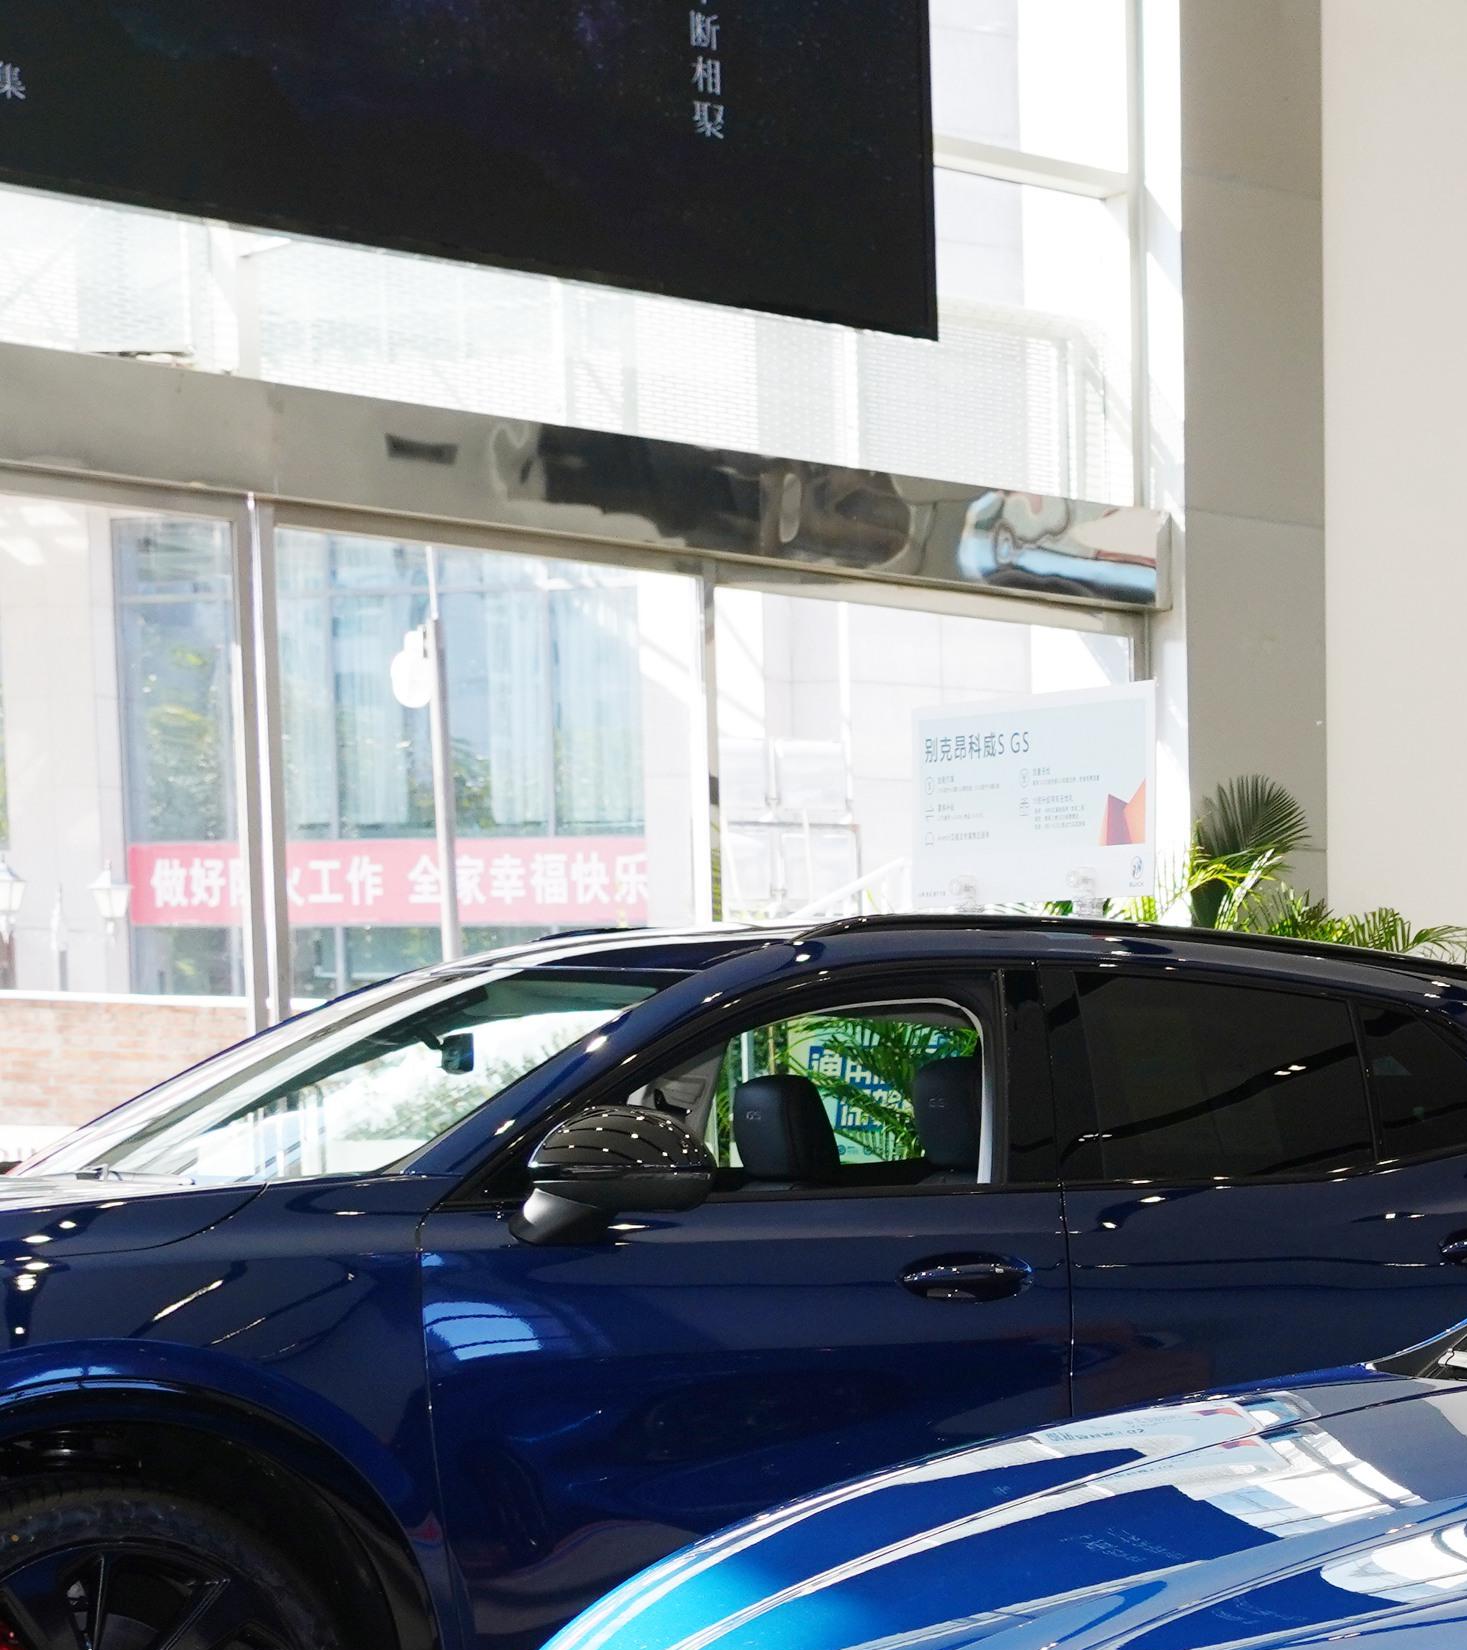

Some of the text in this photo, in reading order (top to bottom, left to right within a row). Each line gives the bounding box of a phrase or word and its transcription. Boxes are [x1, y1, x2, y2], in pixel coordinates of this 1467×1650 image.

[688, 0, 725, 139] 断相聚
[1010, 731, 1031, 755] GS
